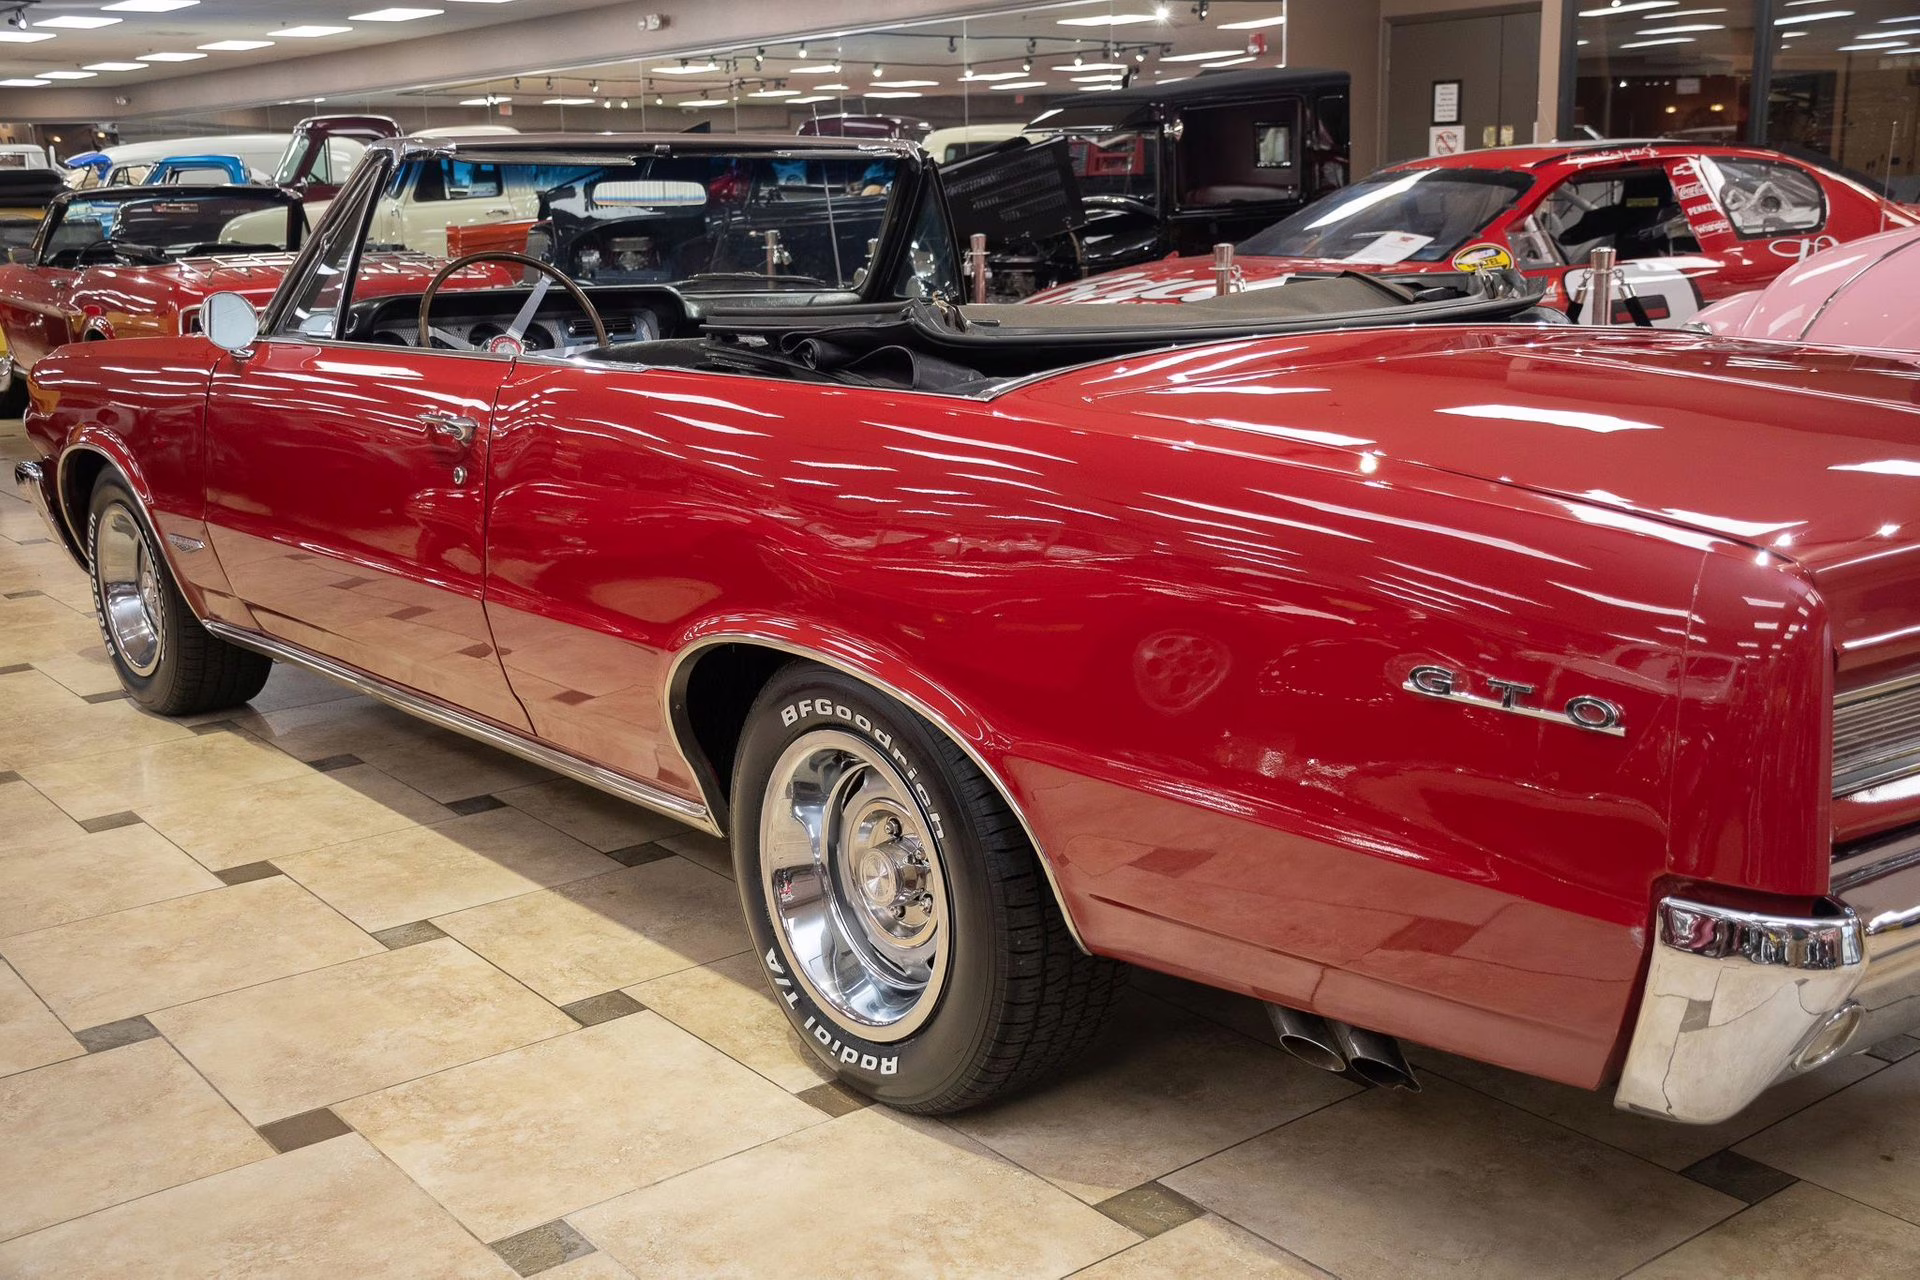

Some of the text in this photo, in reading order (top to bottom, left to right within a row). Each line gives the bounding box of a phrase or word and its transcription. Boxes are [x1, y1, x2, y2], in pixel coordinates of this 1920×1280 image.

[1406, 664, 1621, 730] GTO
[781, 698, 945, 839] BFGoodrich
[764, 947, 898, 1075] Radial T/A
